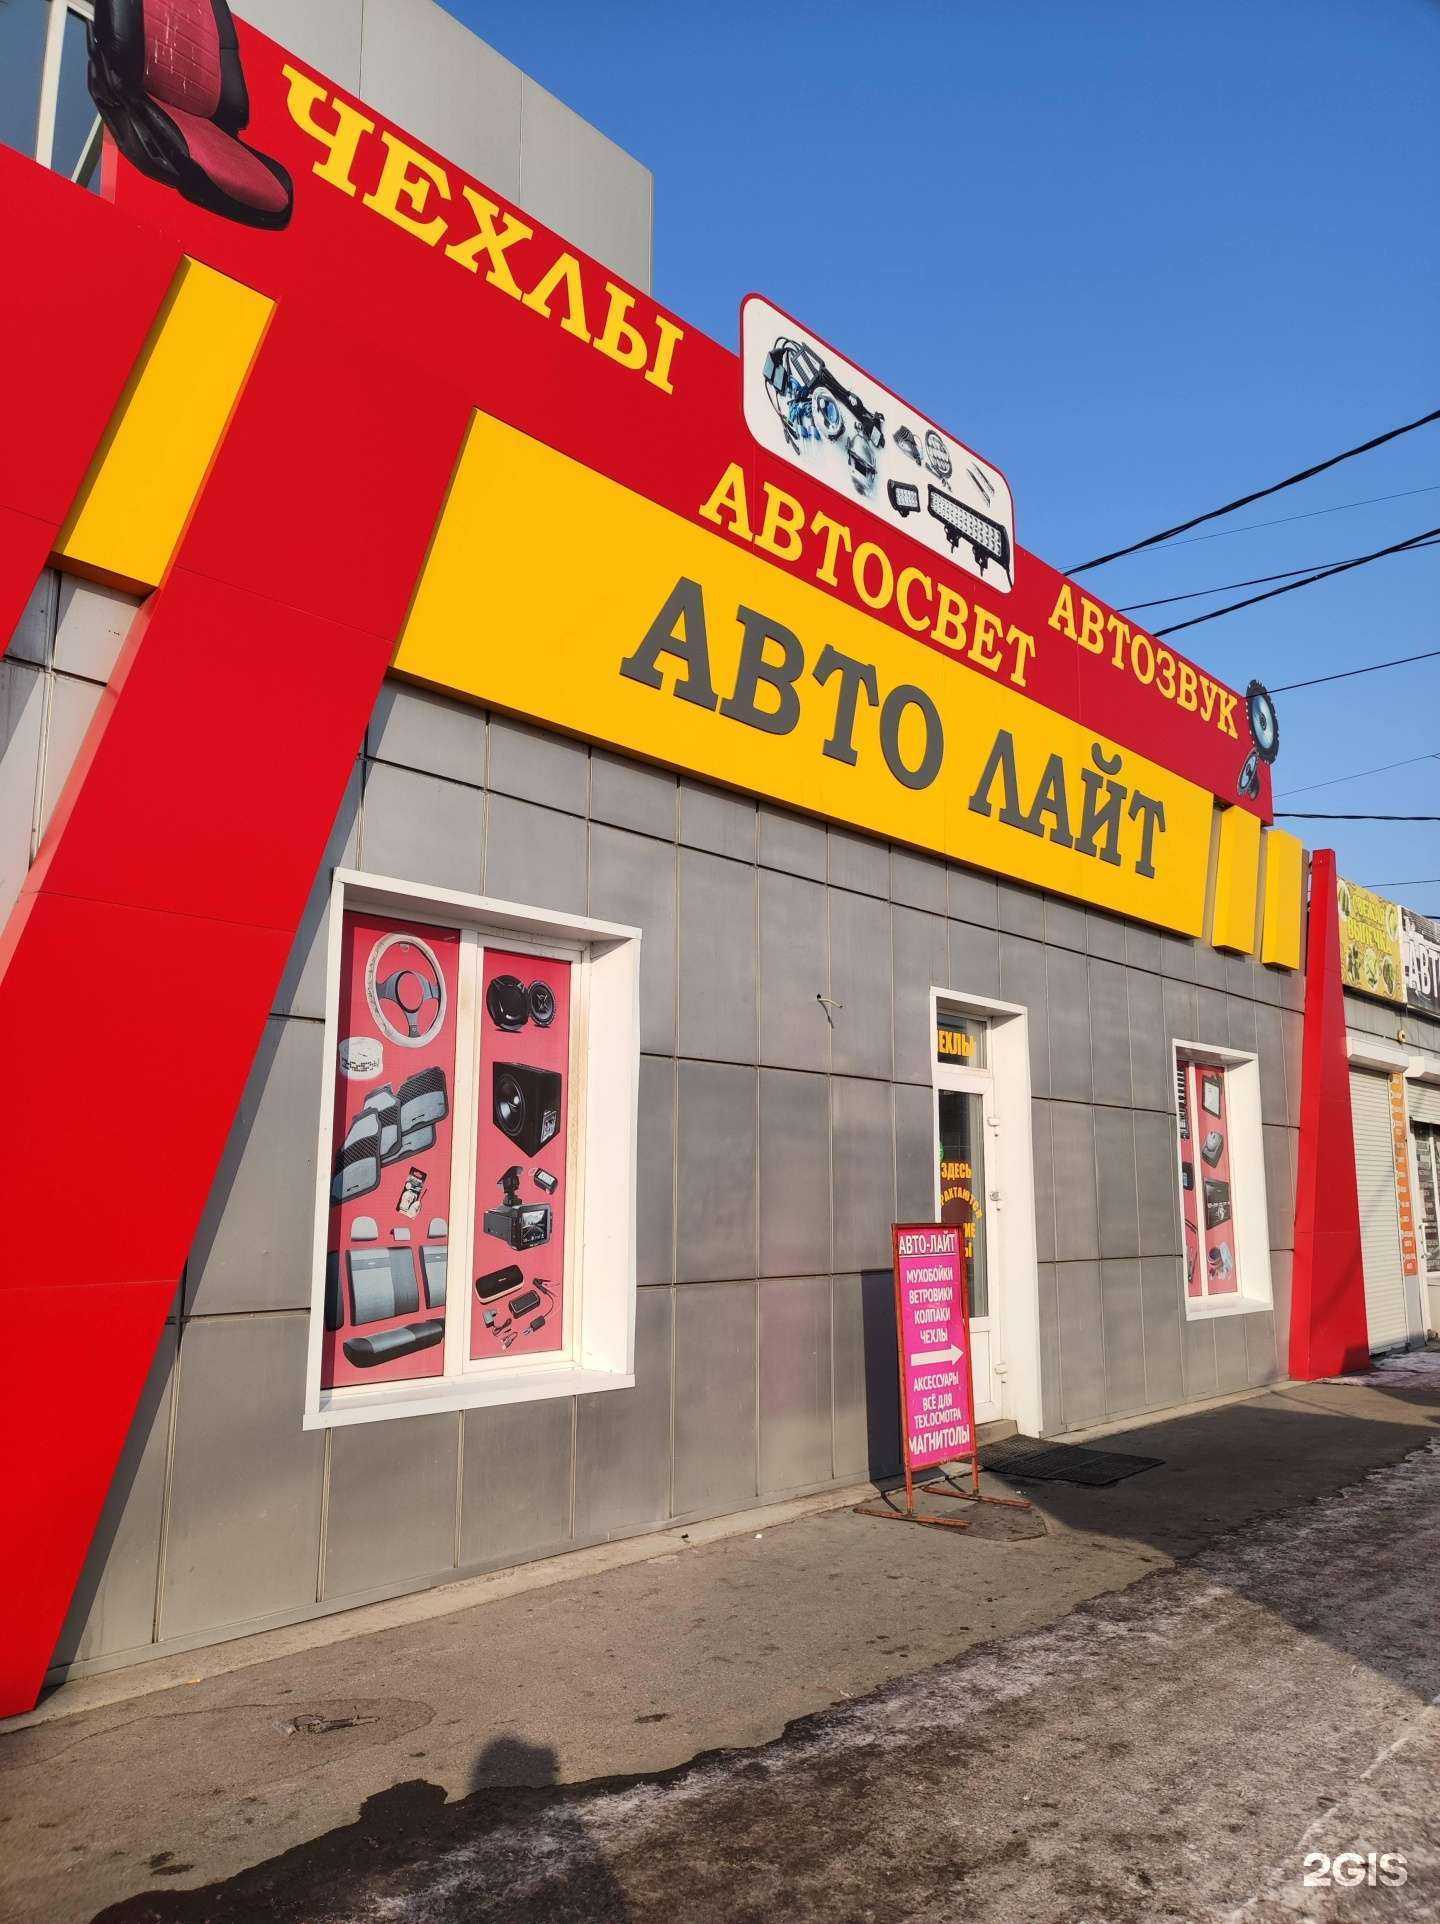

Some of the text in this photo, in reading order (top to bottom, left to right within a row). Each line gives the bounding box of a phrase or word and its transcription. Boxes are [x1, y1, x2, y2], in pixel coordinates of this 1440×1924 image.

[281, 64, 684, 395] ЧЕХЛЫ
[699, 462, 1037, 687] АВТОСВЕТ
[1048, 585, 1239, 739] АВТОЗВУК
[620, 577, 1166, 879] АВТО ЛАЙТ
[937, 1030, 975, 1057] ЕХЛЫ
[941, 1162, 973, 1180] ЗДЕСЬ
[899, 1230, 957, 1254] АВТО-ЛАЙТ
[906, 1264, 953, 1284] МУХОБОЙКИ
[909, 1286, 953, 1305] ВЕТРОВИКИ
[914, 1307, 951, 1325] КОЛПАКИ
[920, 1328, 948, 1344] ЧЕХЛЫ
[913, 1372, 959, 1391] АКСЕССУАРЫ
[922, 1392, 953, 1411] ВСЁ ДЛЯ
[913, 1407, 962, 1429] ТЕХ.ОСМОТРА
[909, 1425, 970, 1454] МАГНИТОЛЫ
